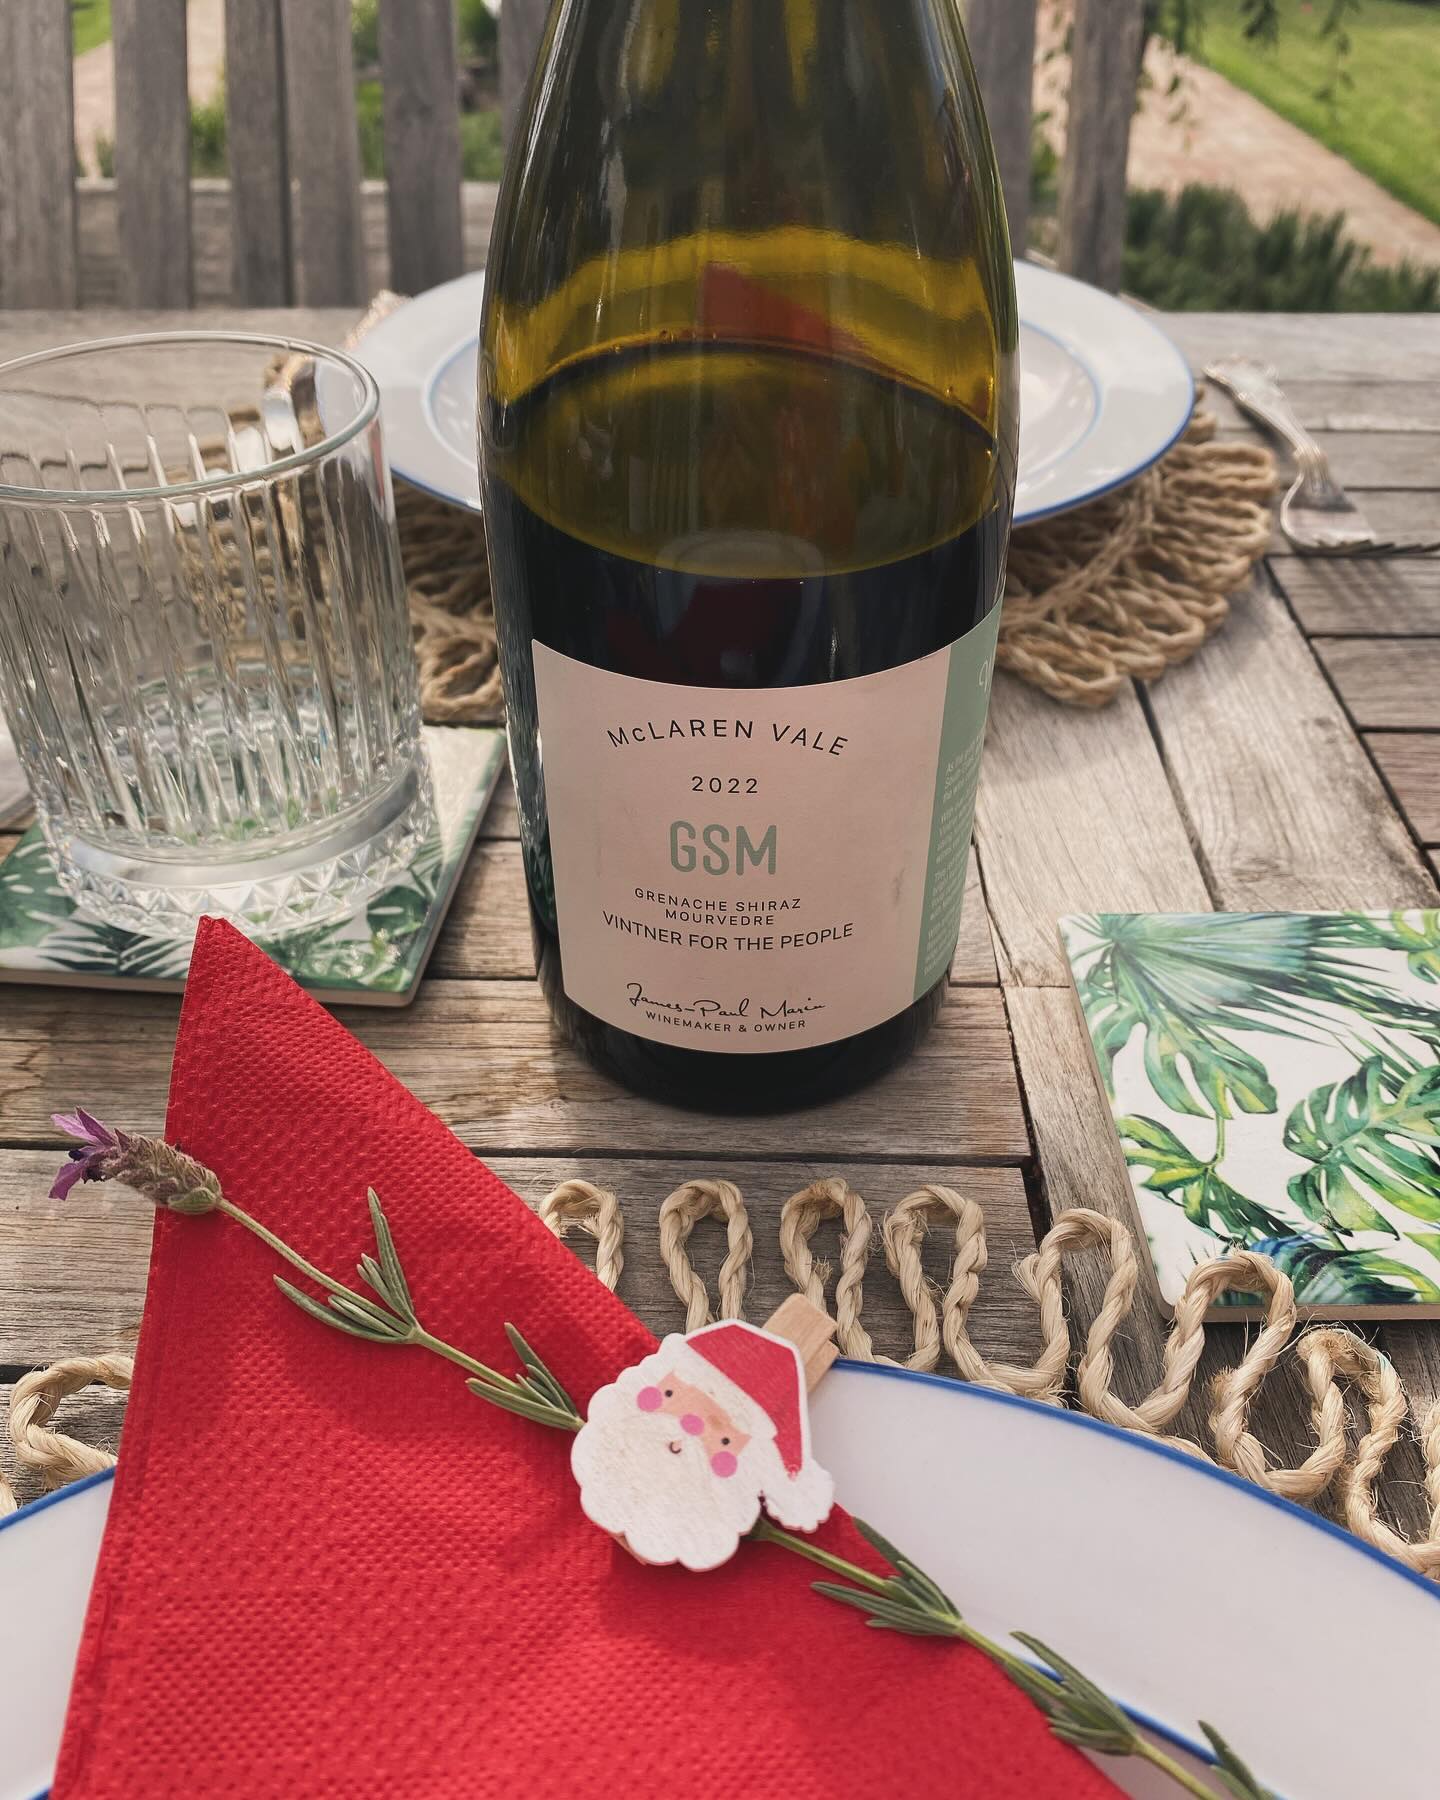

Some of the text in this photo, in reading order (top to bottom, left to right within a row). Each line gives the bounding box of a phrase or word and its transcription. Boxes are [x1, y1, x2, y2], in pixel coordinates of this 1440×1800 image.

[772, 723, 849, 756] VALE
[691, 775, 758, 794] 2022
[669, 820, 777, 877] GSM
[634, 887, 801, 912] GRENACHE SHIRAZ
[602, 910, 854, 950] VINTNER FOR THE PEOPLE
[665, 909, 775, 926] MOURVEDRE
[645, 1010, 807, 1034] WINEMAKER & OWNER
